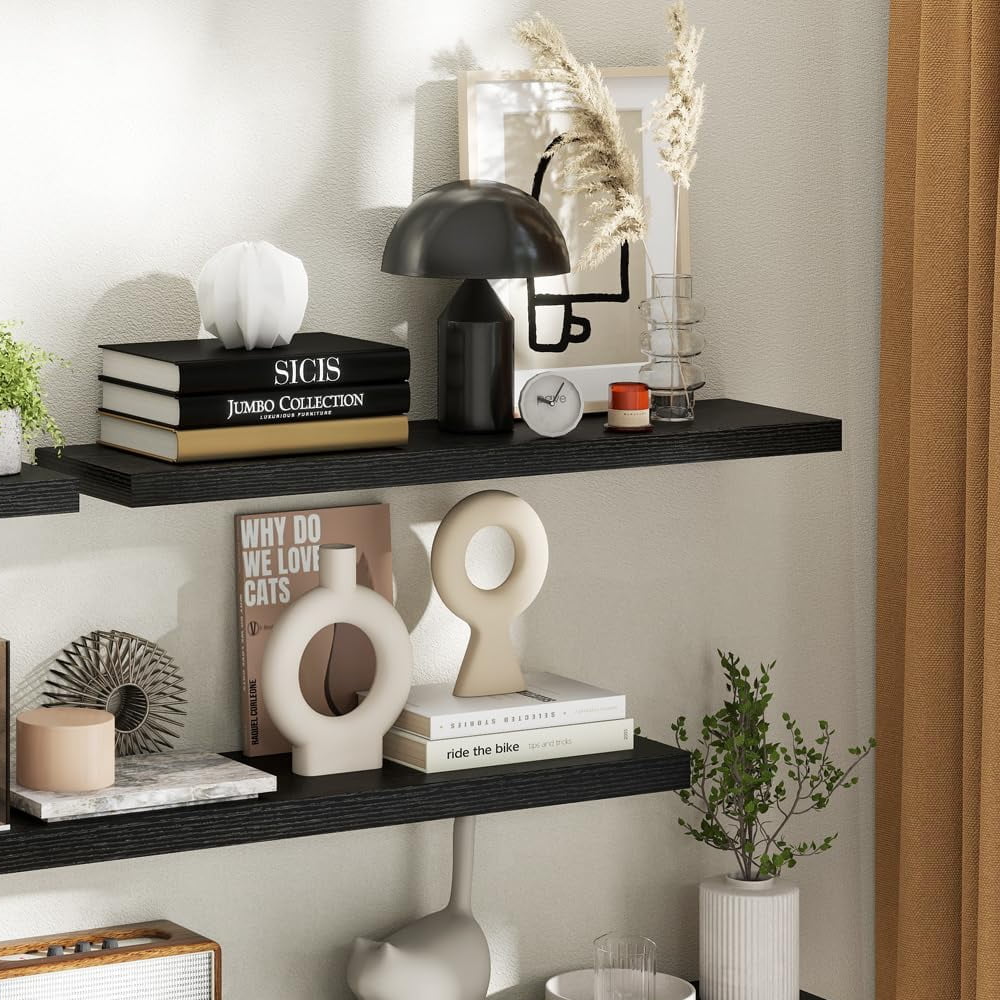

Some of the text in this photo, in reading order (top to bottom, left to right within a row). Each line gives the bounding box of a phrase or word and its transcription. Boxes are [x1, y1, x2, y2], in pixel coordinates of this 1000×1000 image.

[274, 356, 341, 385] SICIS
[240, 513, 321, 549] WHY DO
[242, 545, 320, 578] WE LOVE
[244, 576, 290, 607] CATS
[249, 678, 259, 745] RAQUEL CORLEONE
[446, 741, 520, 760] ride the bike
